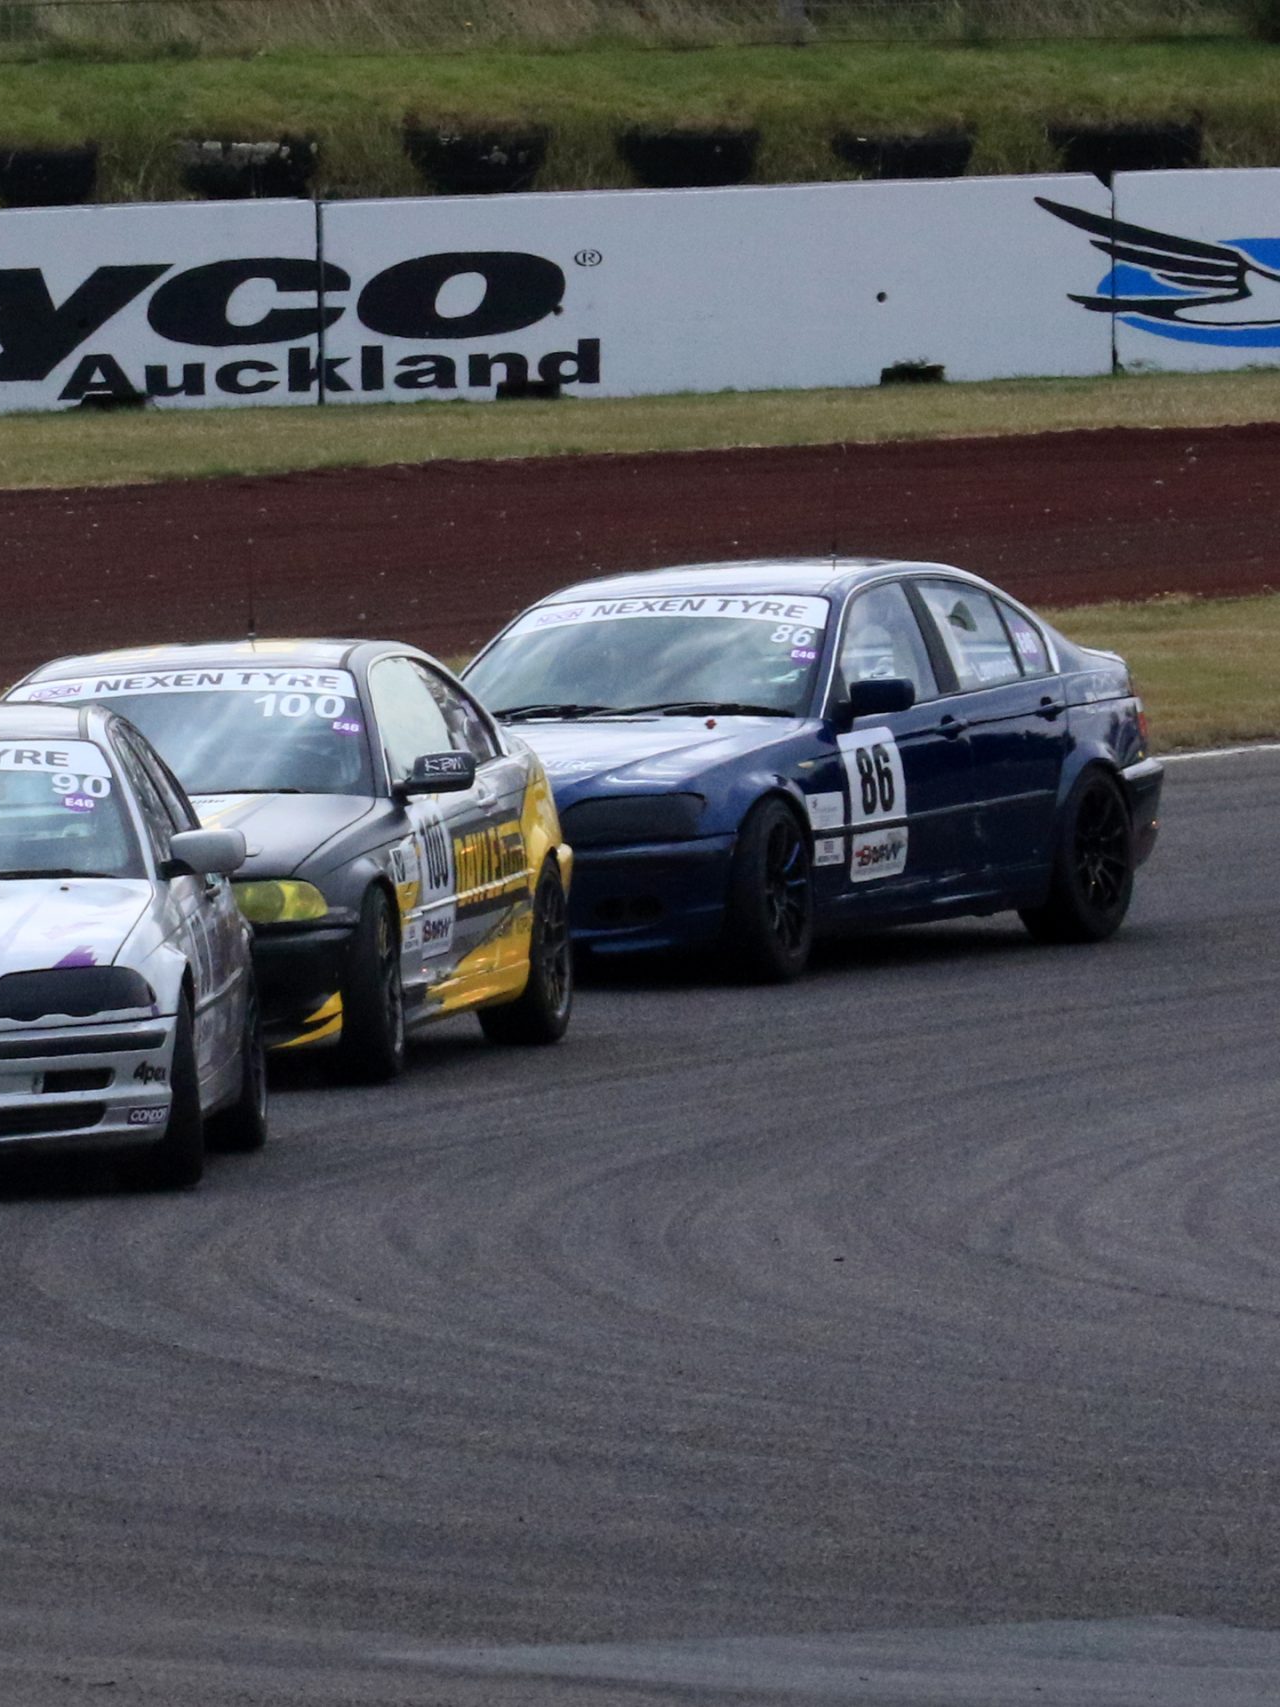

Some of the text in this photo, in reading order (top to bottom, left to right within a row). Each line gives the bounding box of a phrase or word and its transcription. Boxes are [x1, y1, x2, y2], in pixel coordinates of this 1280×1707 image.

[57, 338, 601, 400] Auckland
[591, 599, 706, 617] NEXEN
[717, 599, 808, 619] TYRE
[770, 624, 815, 647] 86
[791, 649, 816, 660] E46
[95, 673, 224, 693] NEXEN
[237, 673, 339, 690] TYRE
[254, 693, 345, 718] 100
[333, 721, 359, 733] E46
[51, 773, 111, 798] 90
[856, 743, 895, 815] 86
[65, 797, 95, 808] E46
